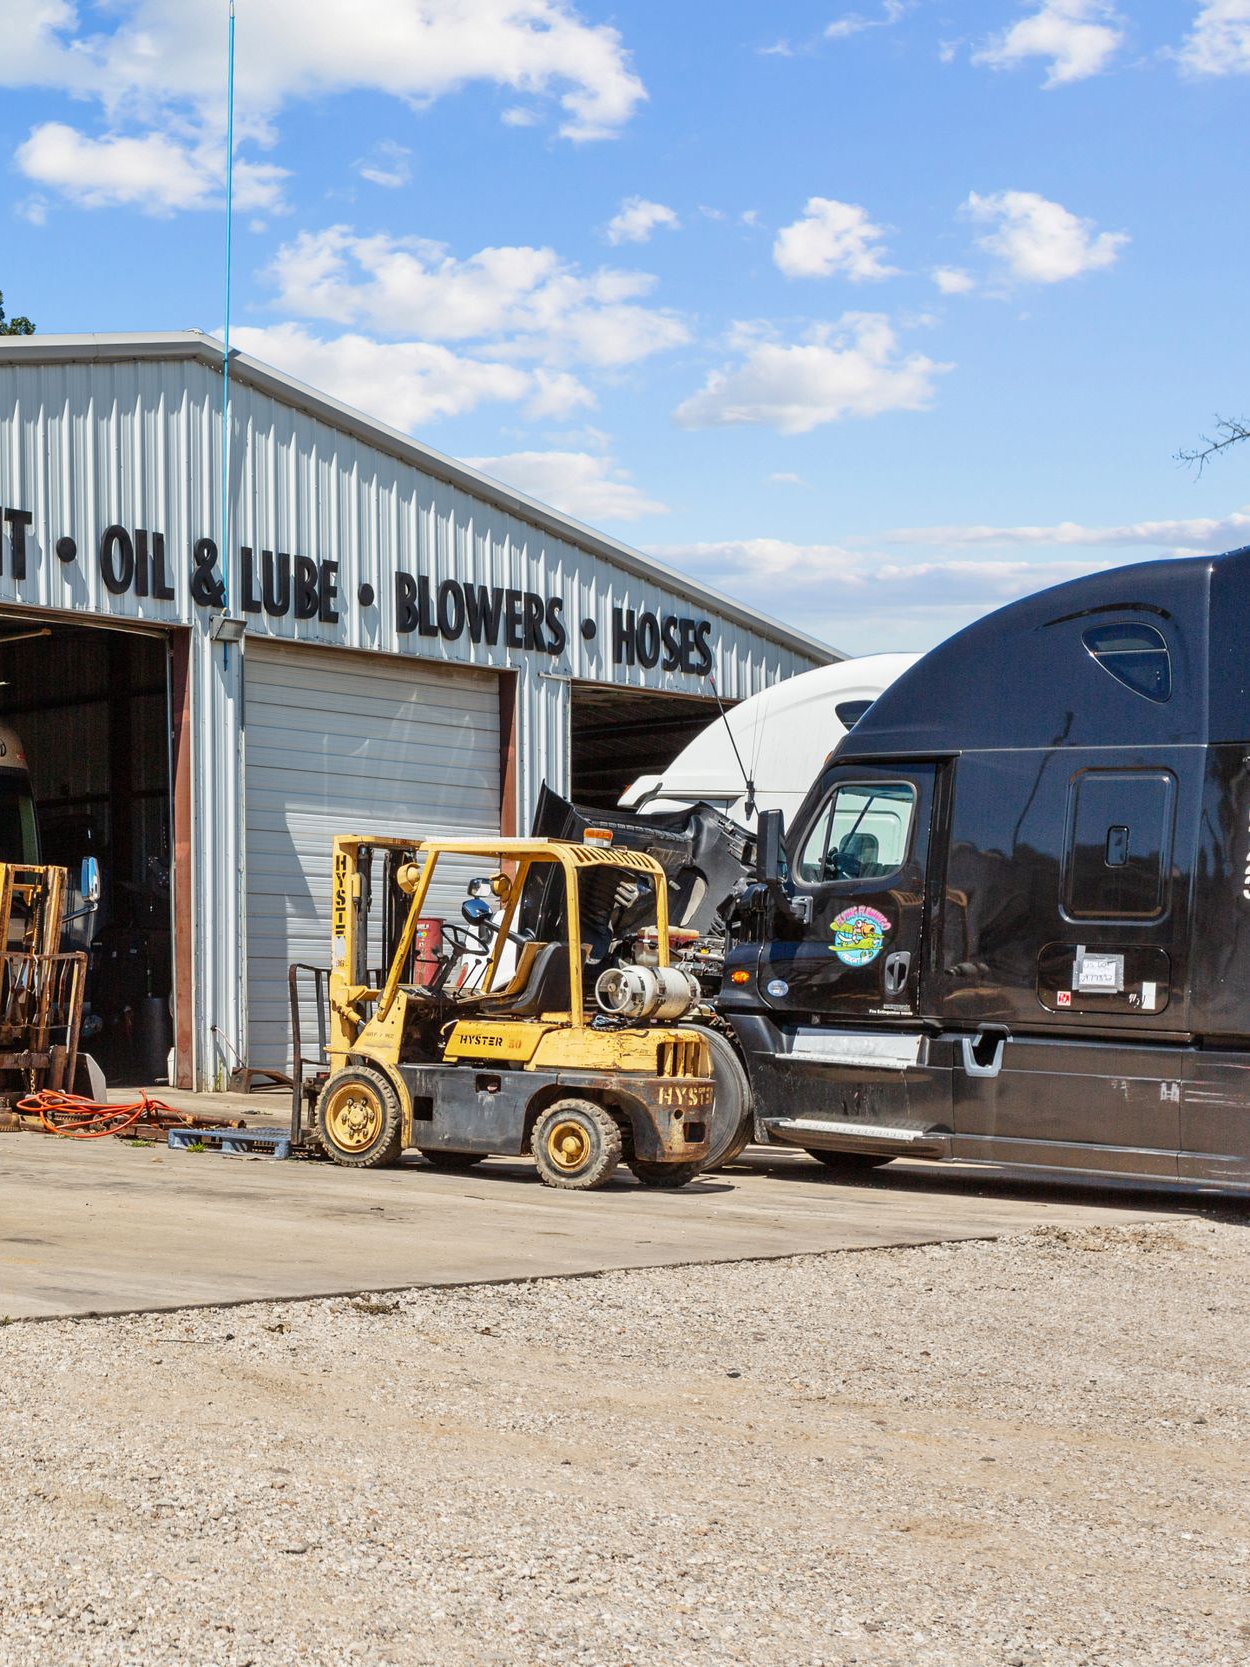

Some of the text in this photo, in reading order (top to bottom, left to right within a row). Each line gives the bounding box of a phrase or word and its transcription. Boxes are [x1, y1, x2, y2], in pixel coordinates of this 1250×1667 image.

[100, 524, 175, 601] OIL
[190, 537, 226, 608] &
[241, 546, 339, 624] LUBE
[395, 570, 567, 656] BLOWERS
[612, 607, 713, 676] HOSES
[459, 1034, 503, 1047] HYSTER
